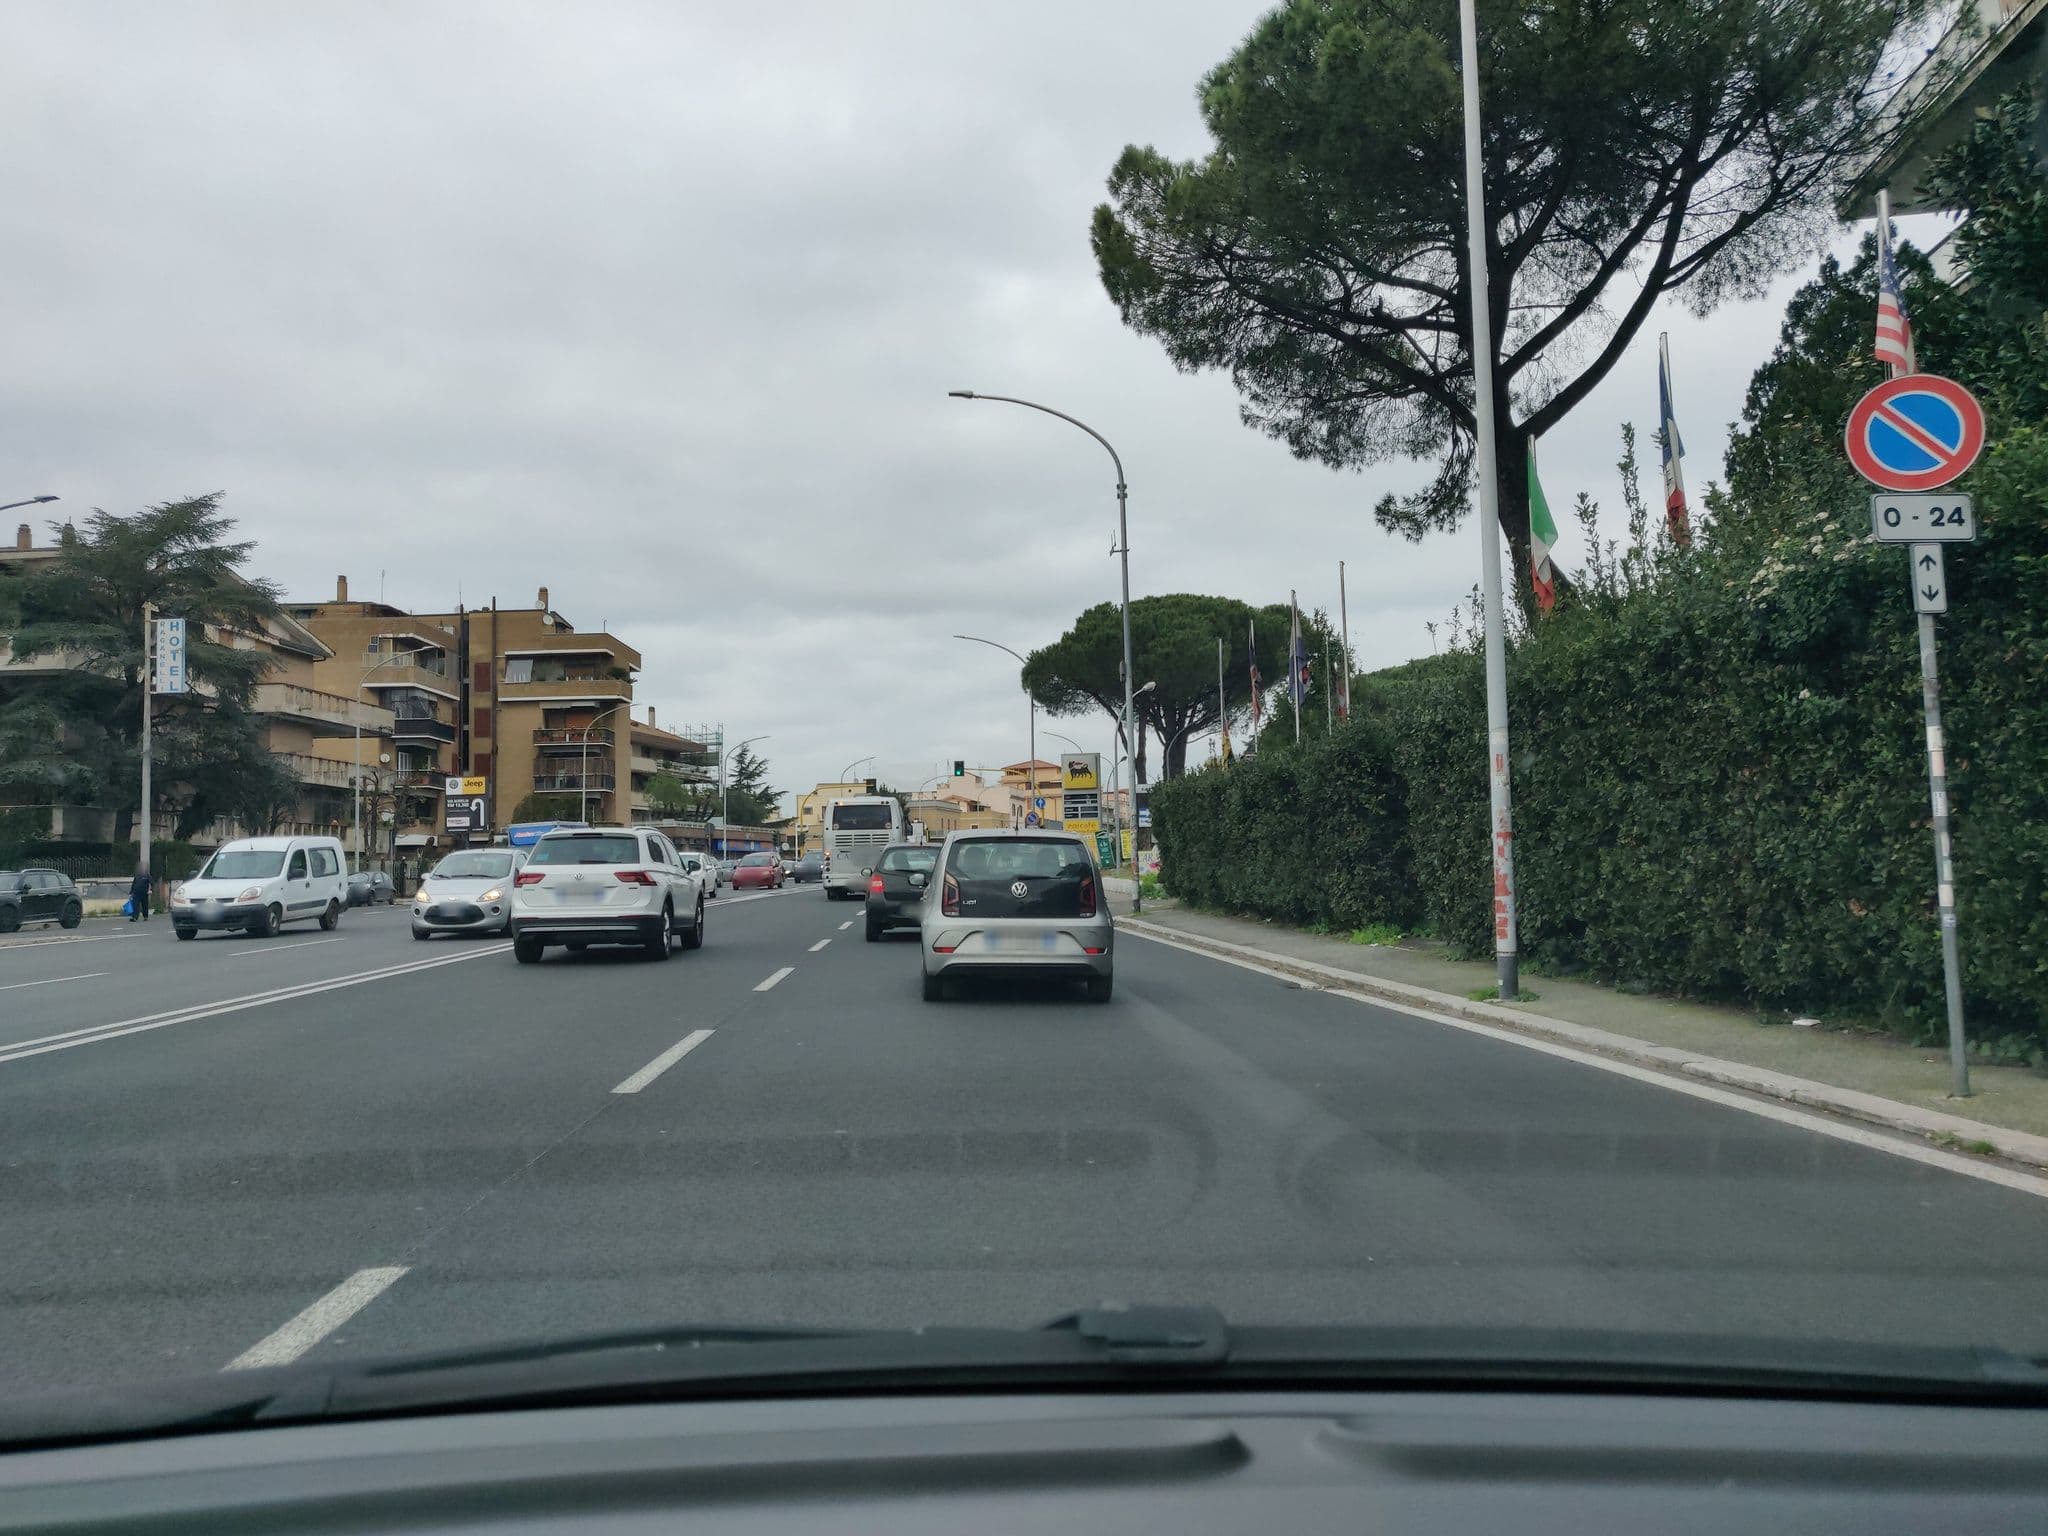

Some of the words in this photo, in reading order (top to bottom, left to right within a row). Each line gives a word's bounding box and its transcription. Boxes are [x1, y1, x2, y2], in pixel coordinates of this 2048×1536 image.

[1884, 507, 1901, 528] 0
[1929, 506, 1965, 527] 24
[170, 622, 180, 691] HOTEL
[464, 779, 483, 788] Jeep
